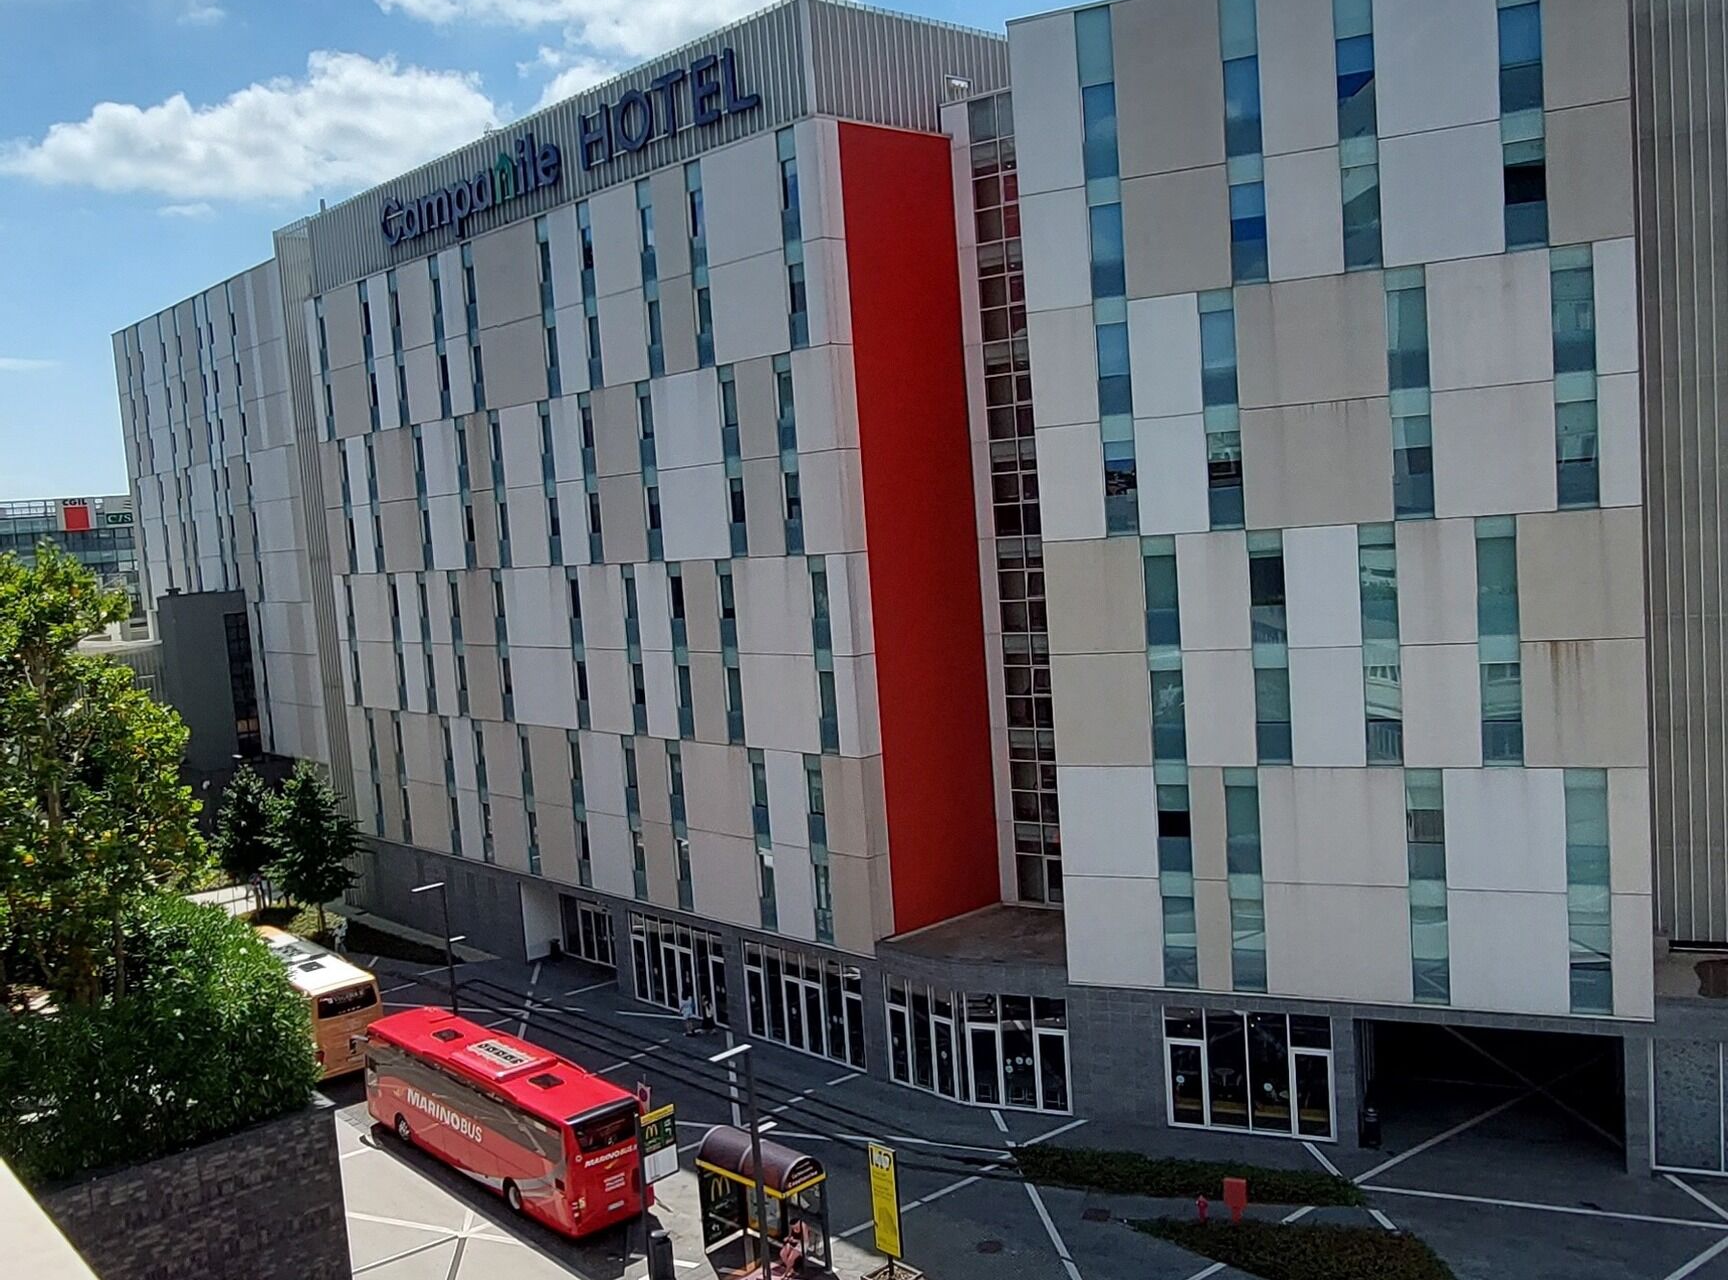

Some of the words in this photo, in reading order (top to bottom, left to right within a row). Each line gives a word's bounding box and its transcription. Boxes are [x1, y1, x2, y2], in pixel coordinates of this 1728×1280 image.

[381, 133, 561, 246] Campanile
[578, 48, 761, 171] HOTEL
[62, 498, 87, 506] CGIL
[407, 1087, 482, 1143] MARINOBUS
